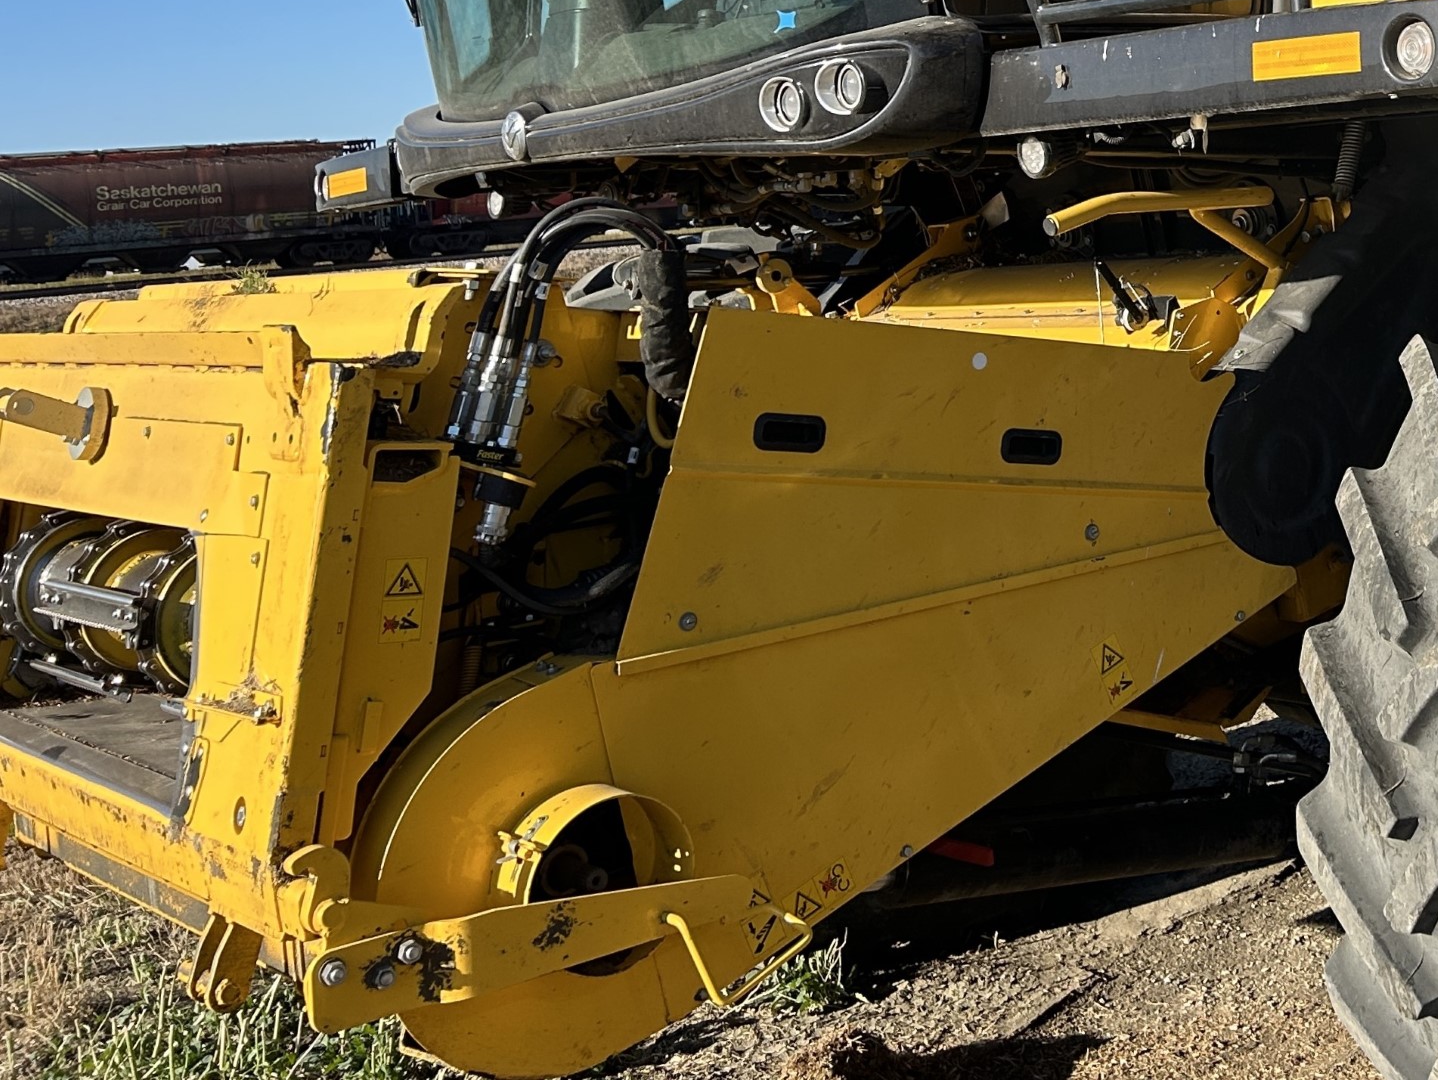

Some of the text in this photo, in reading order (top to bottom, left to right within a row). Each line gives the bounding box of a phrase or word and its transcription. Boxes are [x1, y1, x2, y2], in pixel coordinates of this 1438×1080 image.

[96, 182, 223, 201] Saskatchewan
[96, 195, 223, 212] Grain Car Corporation
[476, 449, 505, 461] Faster
